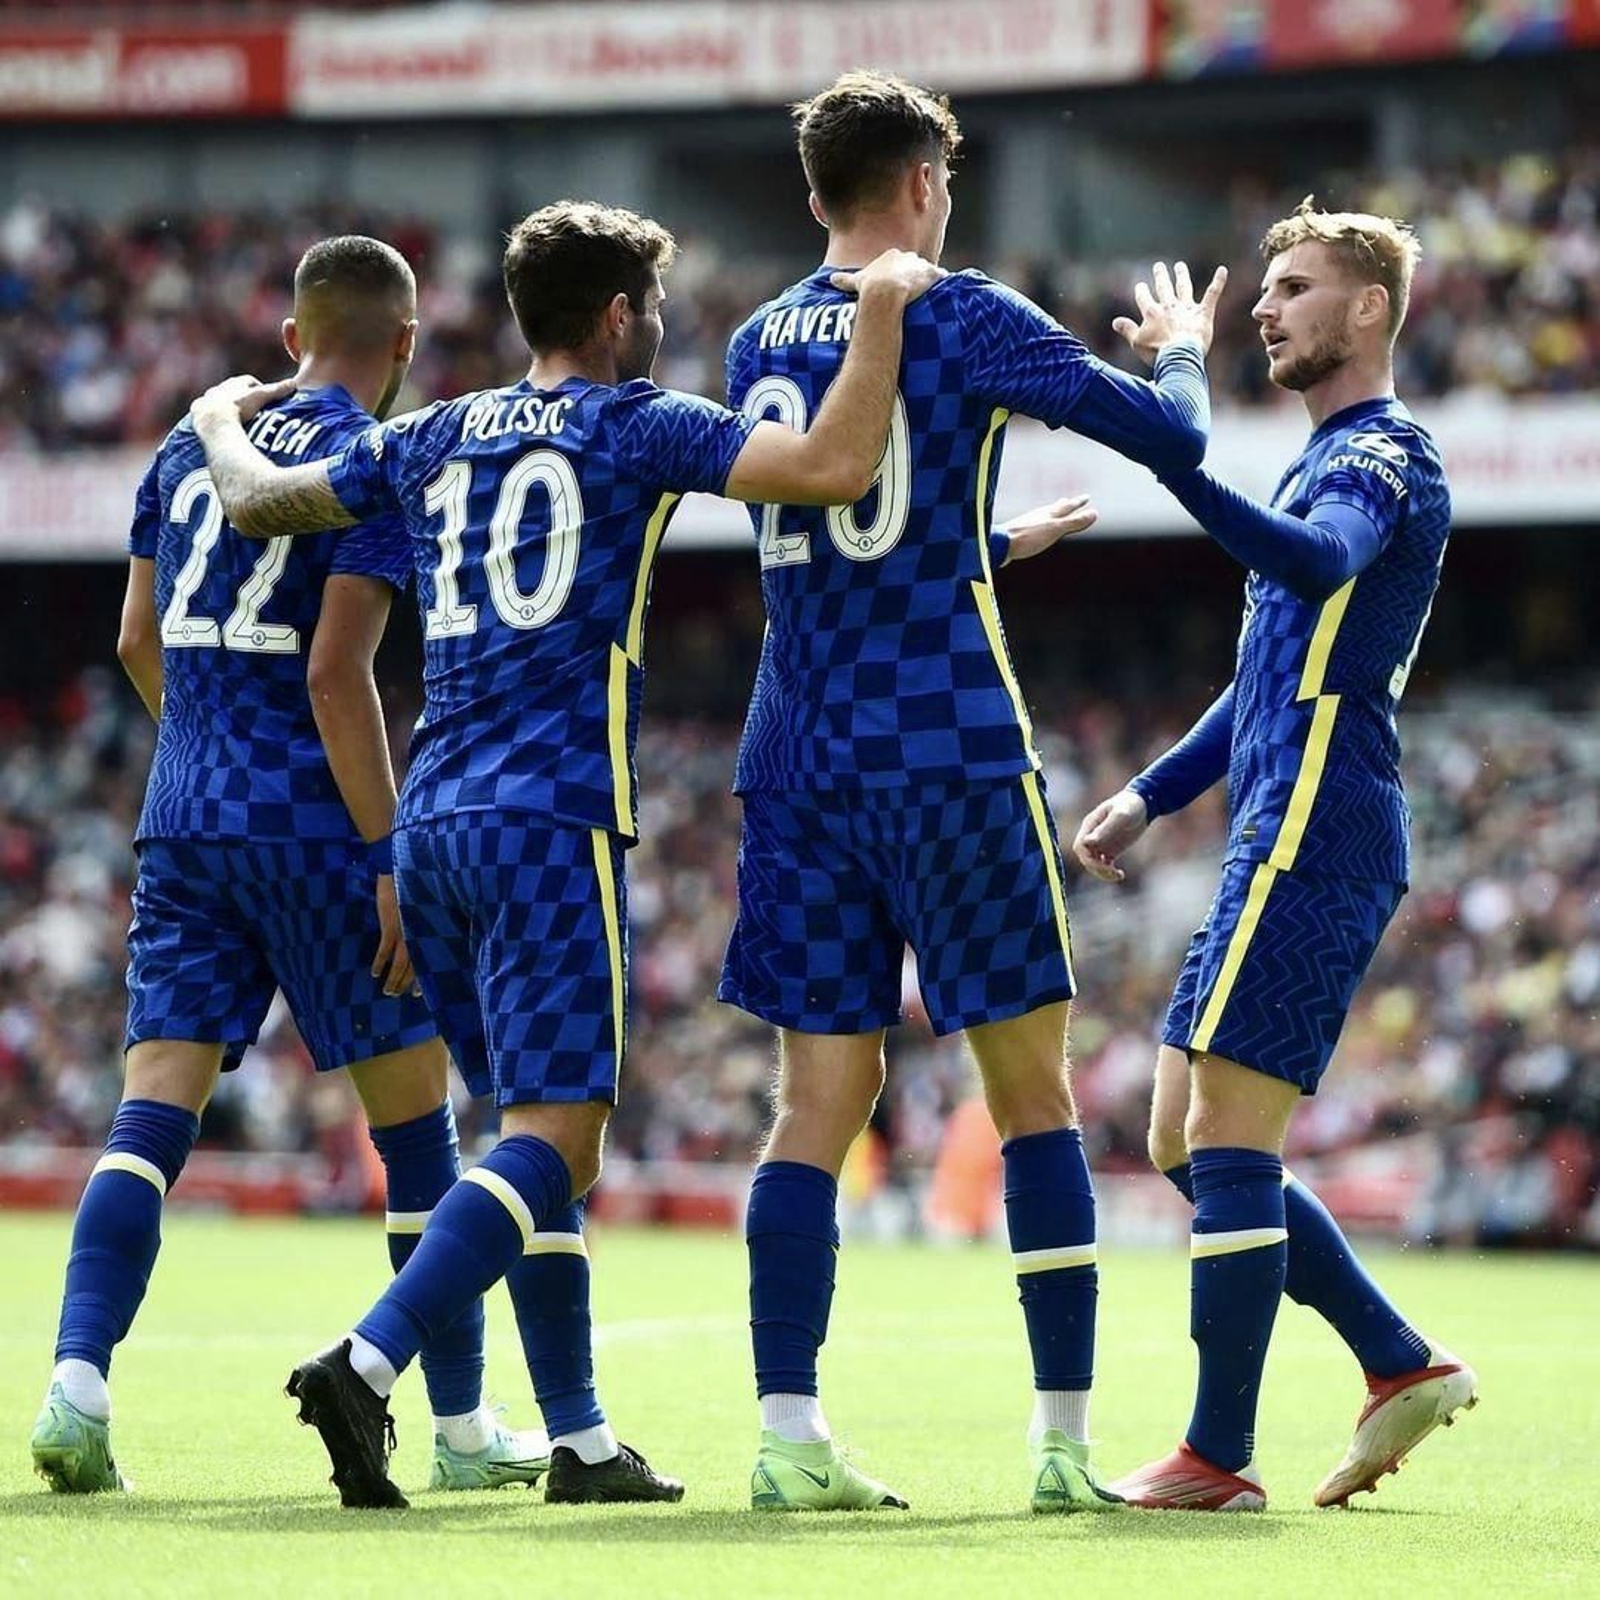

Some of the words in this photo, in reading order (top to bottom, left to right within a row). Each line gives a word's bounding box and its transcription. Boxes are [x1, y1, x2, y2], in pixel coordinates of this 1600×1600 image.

[759, 303, 857, 350] HAVER
[1326, 454, 1408, 500] HYUNDAI
[161, 466, 300, 653] 22
[424, 449, 584, 641] 10
